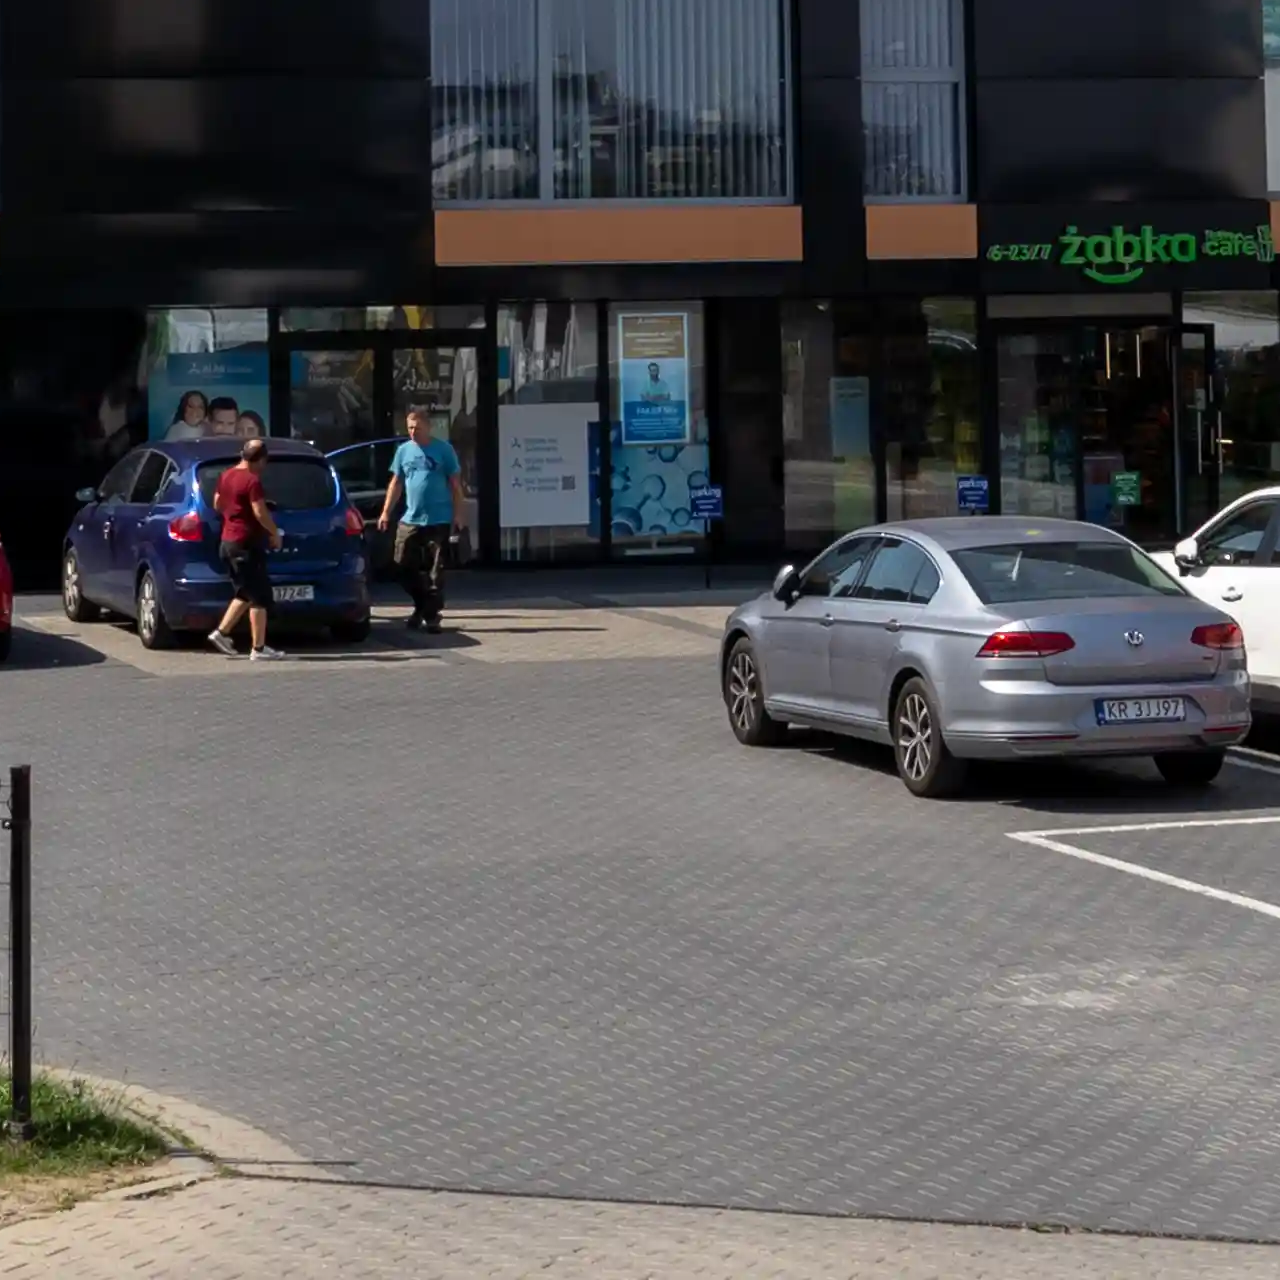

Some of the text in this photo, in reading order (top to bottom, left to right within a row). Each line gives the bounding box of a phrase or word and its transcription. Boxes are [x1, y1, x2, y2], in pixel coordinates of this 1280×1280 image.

[1059, 225, 1197, 264] żabka
[1106, 700, 1180, 718] KR 3JJ97
